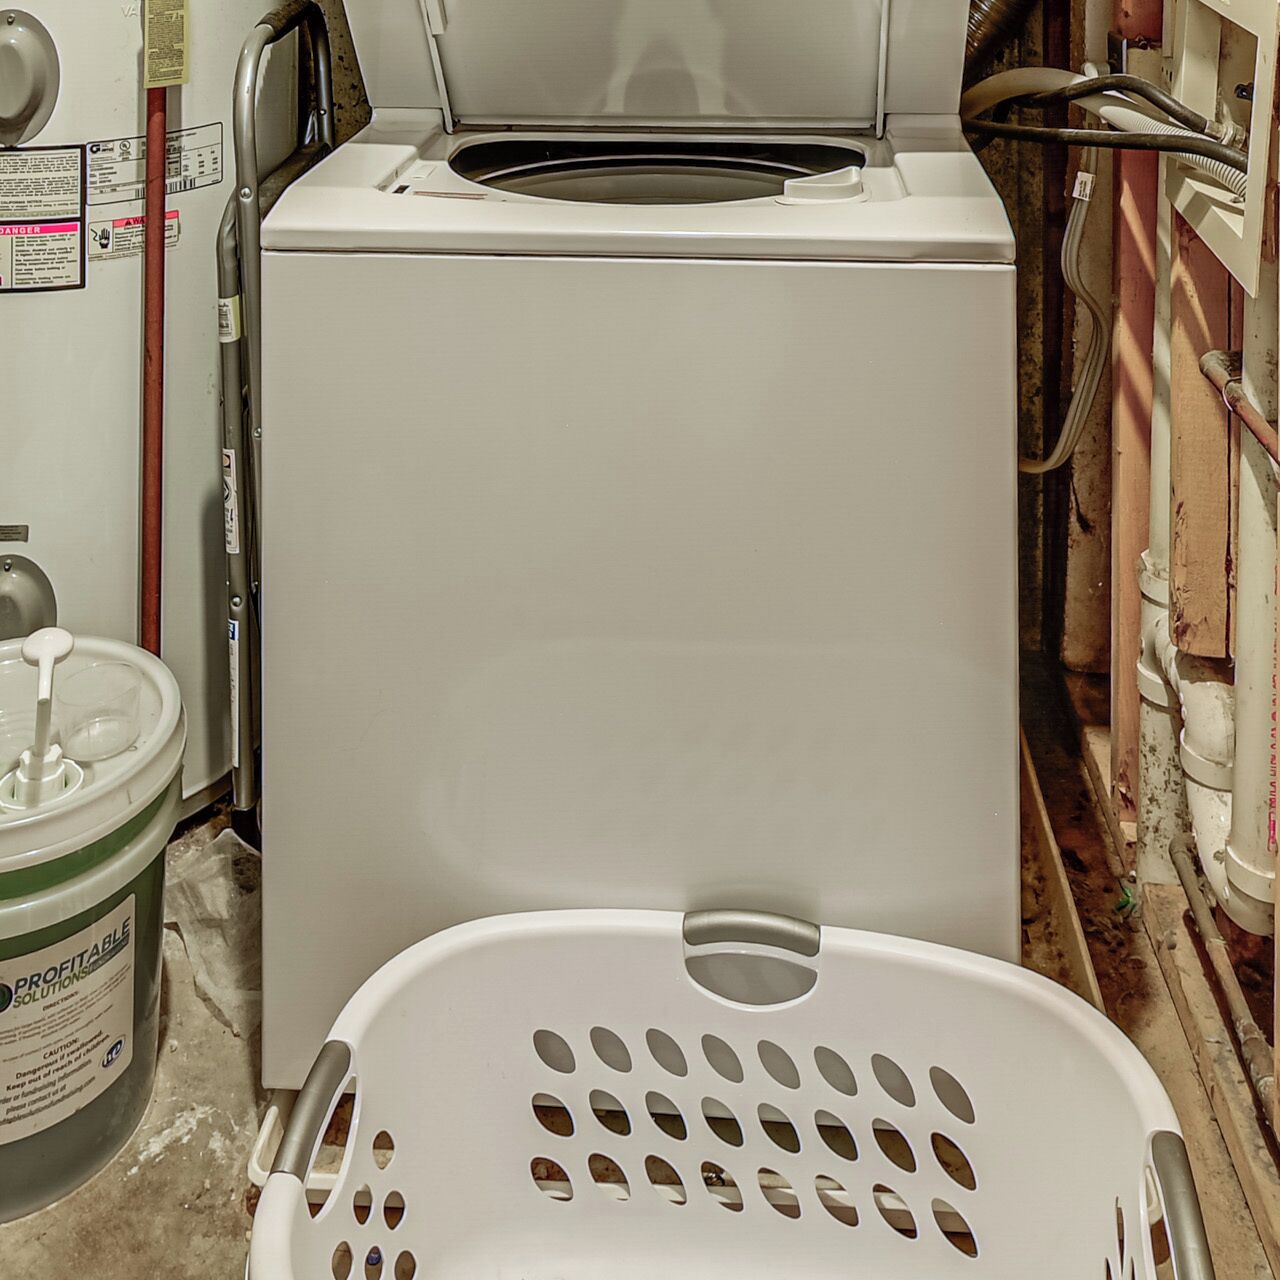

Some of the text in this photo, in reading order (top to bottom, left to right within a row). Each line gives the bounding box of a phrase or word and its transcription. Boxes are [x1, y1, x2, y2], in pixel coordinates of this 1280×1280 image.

[14, 917, 130, 995] PROFITABLE
[13, 964, 91, 1008] SOLUTIONS
[16, 1059, 58, 1079] Dangerous
[67, 1030, 103, 1057] swallowed.
[43, 1037, 79, 1059] CAUTION:
[6, 1081, 25, 1091] Keep
[28, 1075, 42, 1085] out
[43, 1070, 51, 1078] of
[52, 1060, 72, 1074] reach
[74, 1054, 82, 1064] of
[13, 1093, 21, 1102] or
[21, 1077, 56, 1099] fundraising
[6, 1102, 26, 1115] please
[28, 1091, 51, 1106] contact
